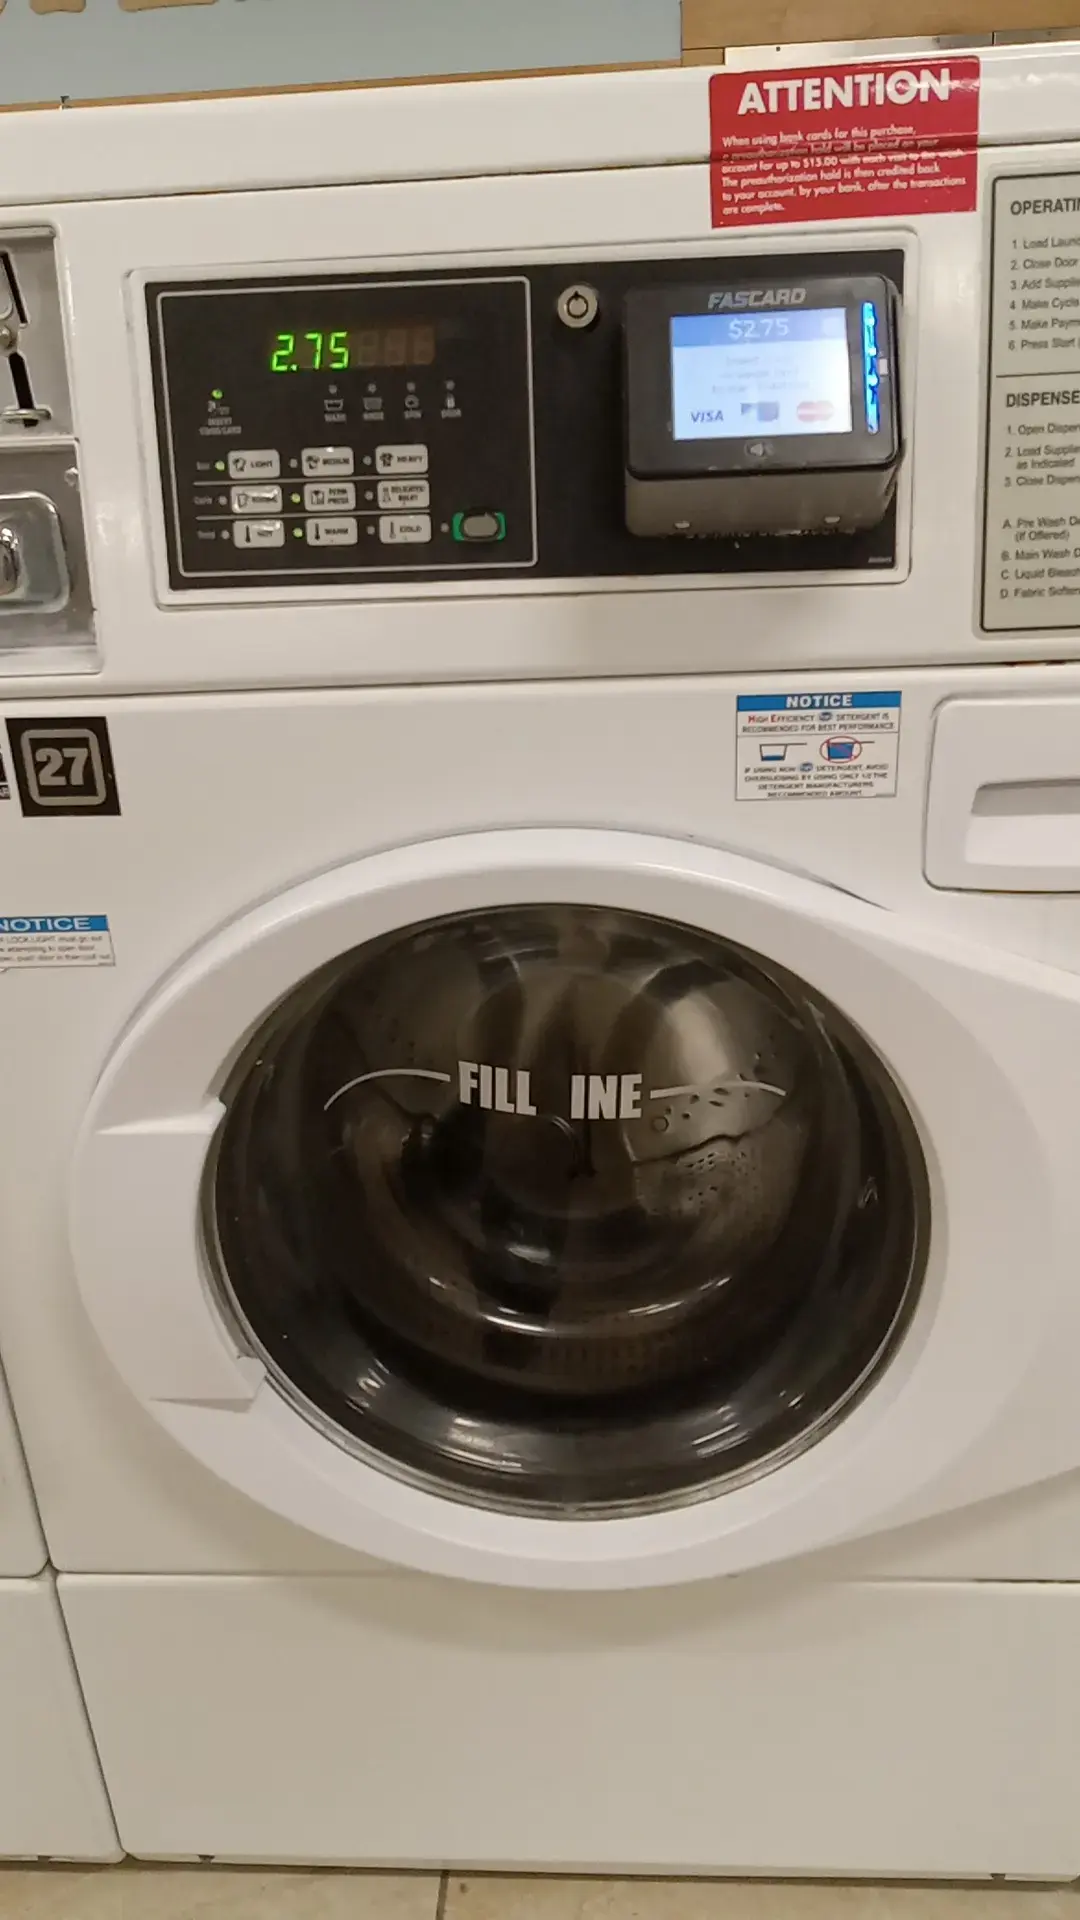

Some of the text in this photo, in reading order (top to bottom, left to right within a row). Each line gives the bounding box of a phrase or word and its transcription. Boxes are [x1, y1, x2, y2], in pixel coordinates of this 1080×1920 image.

[738, 68, 950, 116] ATTENTION
[722, 136, 750, 147] When
[751, 135, 778, 146] using
[779, 130, 804, 142] bank
[805, 128, 833, 141] cards
[834, 127, 849, 139] for
[851, 127, 868, 138] this
[721, 163, 758, 174] account
[759, 160, 774, 171] for
[775, 162, 789, 172] up
[790, 160, 801, 169] to
[722, 176, 739, 187] The
[819, 168, 842, 180] hold
[843, 168, 852, 179] is
[853, 166, 876, 178] then
[876, 163, 916, 177] credited
[916, 161, 940, 174] back
[722, 192, 733, 201] to
[733, 191, 757, 203] your
[798, 184, 813, 198] by
[812, 186, 836, 198] your
[867, 179, 890, 192] after
[892, 178, 909, 189] the
[909, 176, 967, 189] transactions
[722, 207, 740, 215] are
[1023, 237, 1049, 250] Load
[1023, 258, 1052, 270] Close
[1054, 256, 1079, 269] Door
[1021, 278, 1043, 290] Add
[708, 288, 807, 309] FASCARD
[271, 331, 350, 372] 2.75
[691, 410, 725, 424] VISA
[1018, 424, 1045, 437] Open
[786, 694, 853, 709] NOTICE
[35, 747, 89, 786] 27
[458, 1060, 537, 1116] FILL
